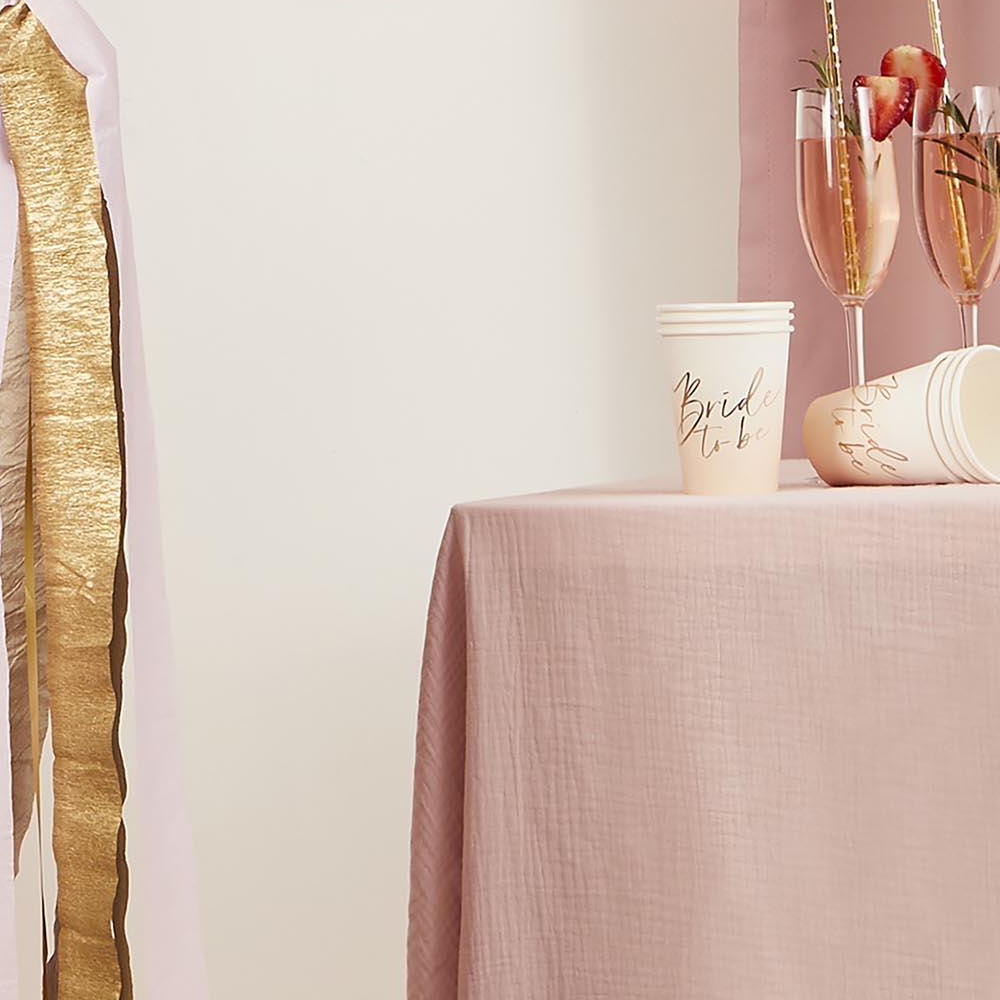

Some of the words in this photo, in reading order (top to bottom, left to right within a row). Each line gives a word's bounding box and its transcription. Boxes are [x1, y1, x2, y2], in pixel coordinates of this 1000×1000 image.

[673, 366, 781, 446] Bride
[693, 423, 730, 459] to
[736, 415, 769, 450] be
